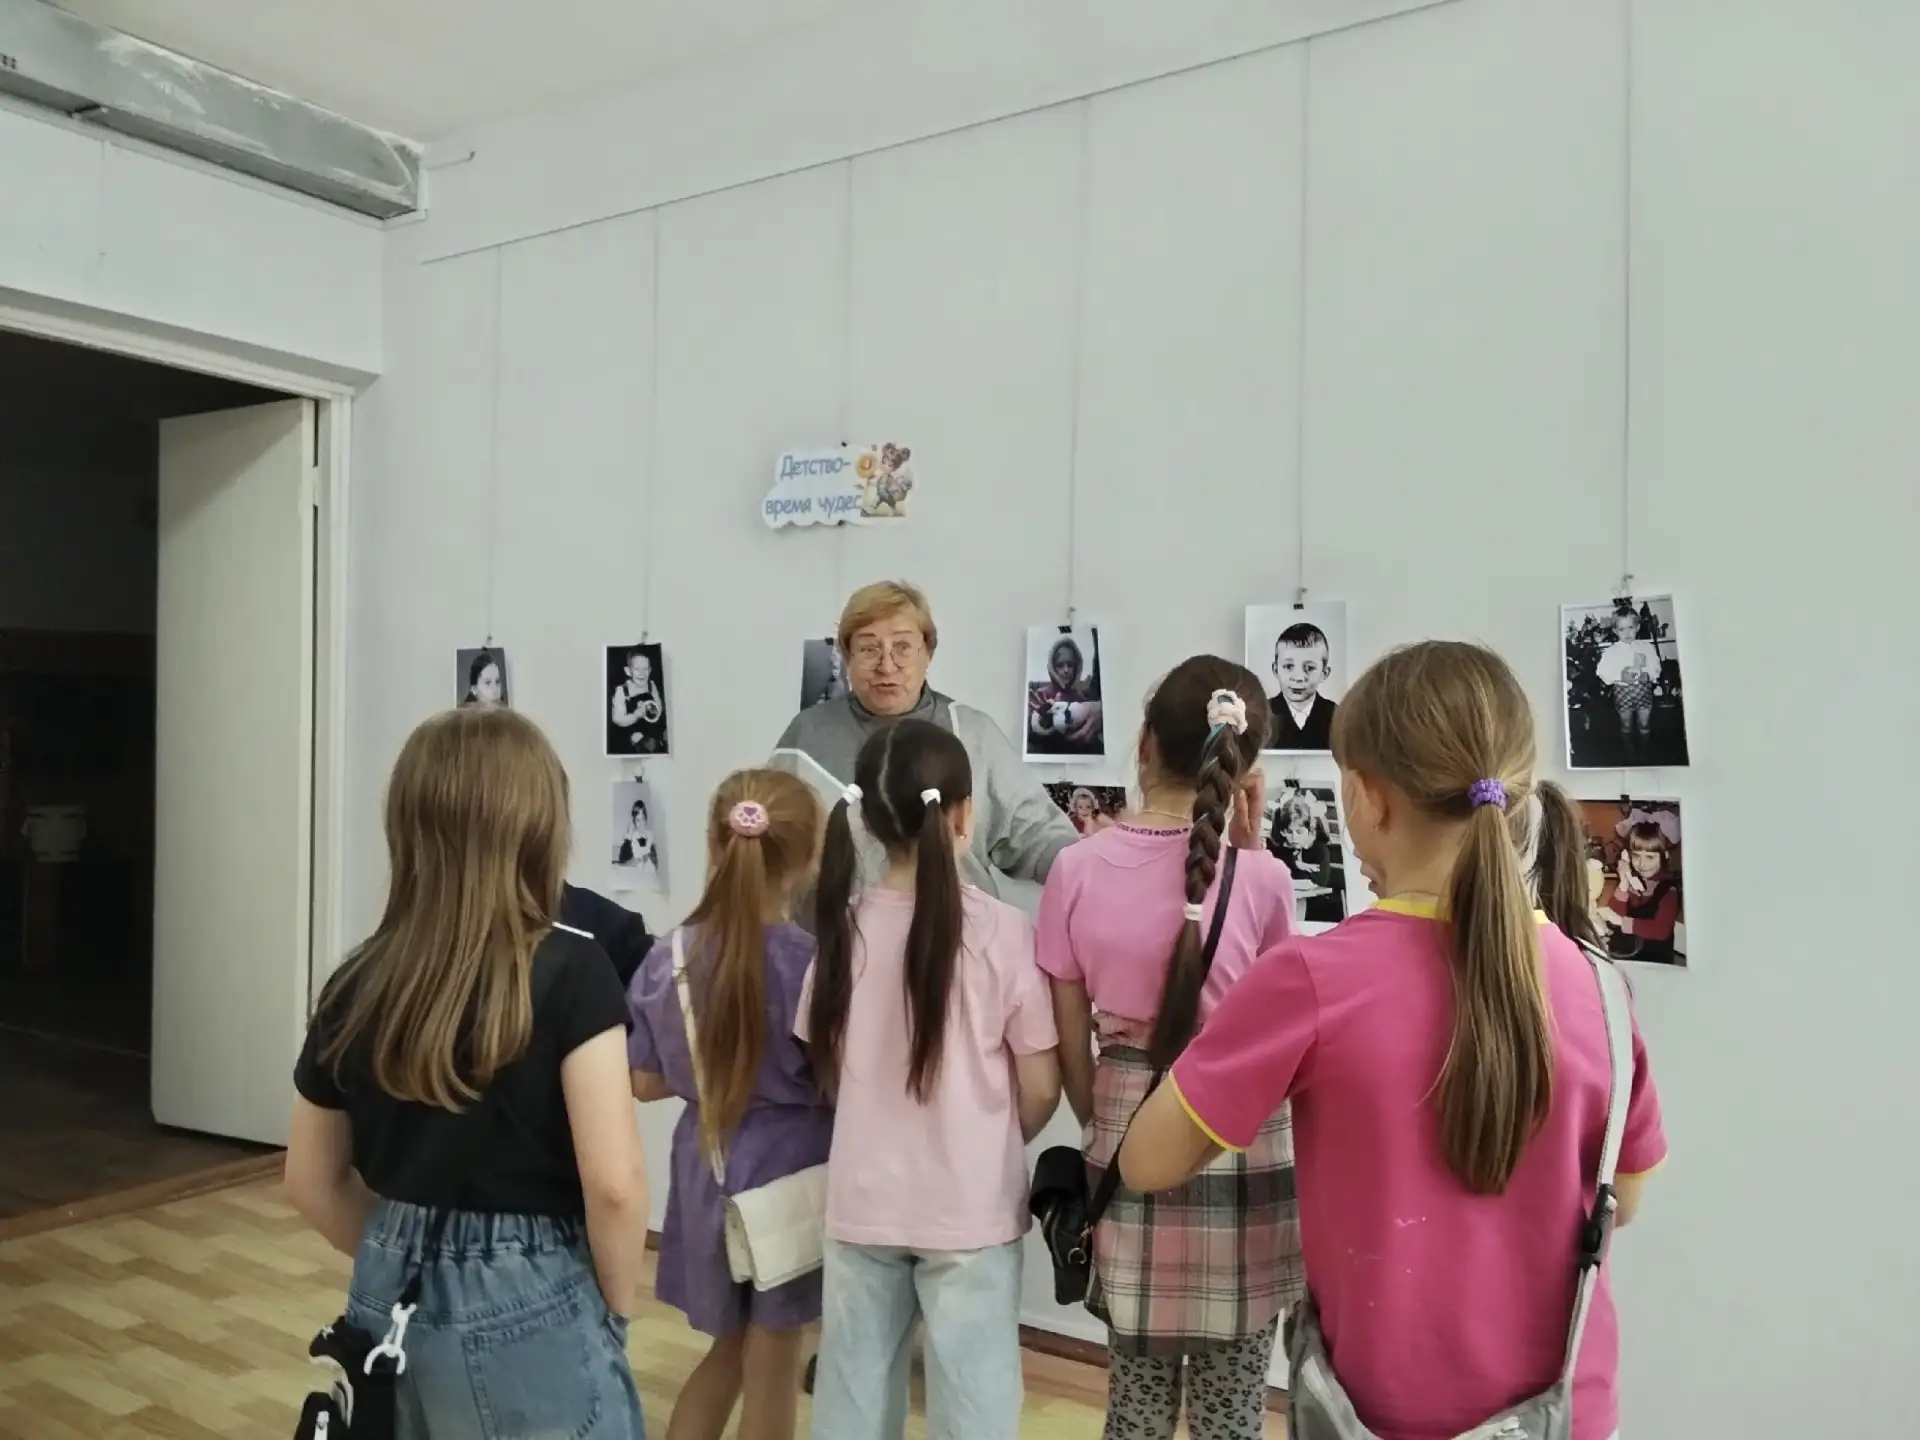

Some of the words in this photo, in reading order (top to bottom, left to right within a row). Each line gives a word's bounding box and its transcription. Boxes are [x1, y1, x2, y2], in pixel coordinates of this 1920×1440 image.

[780, 455, 852, 480] Детство-
[765, 498, 812, 522] время
[817, 495, 863, 519] чудес
